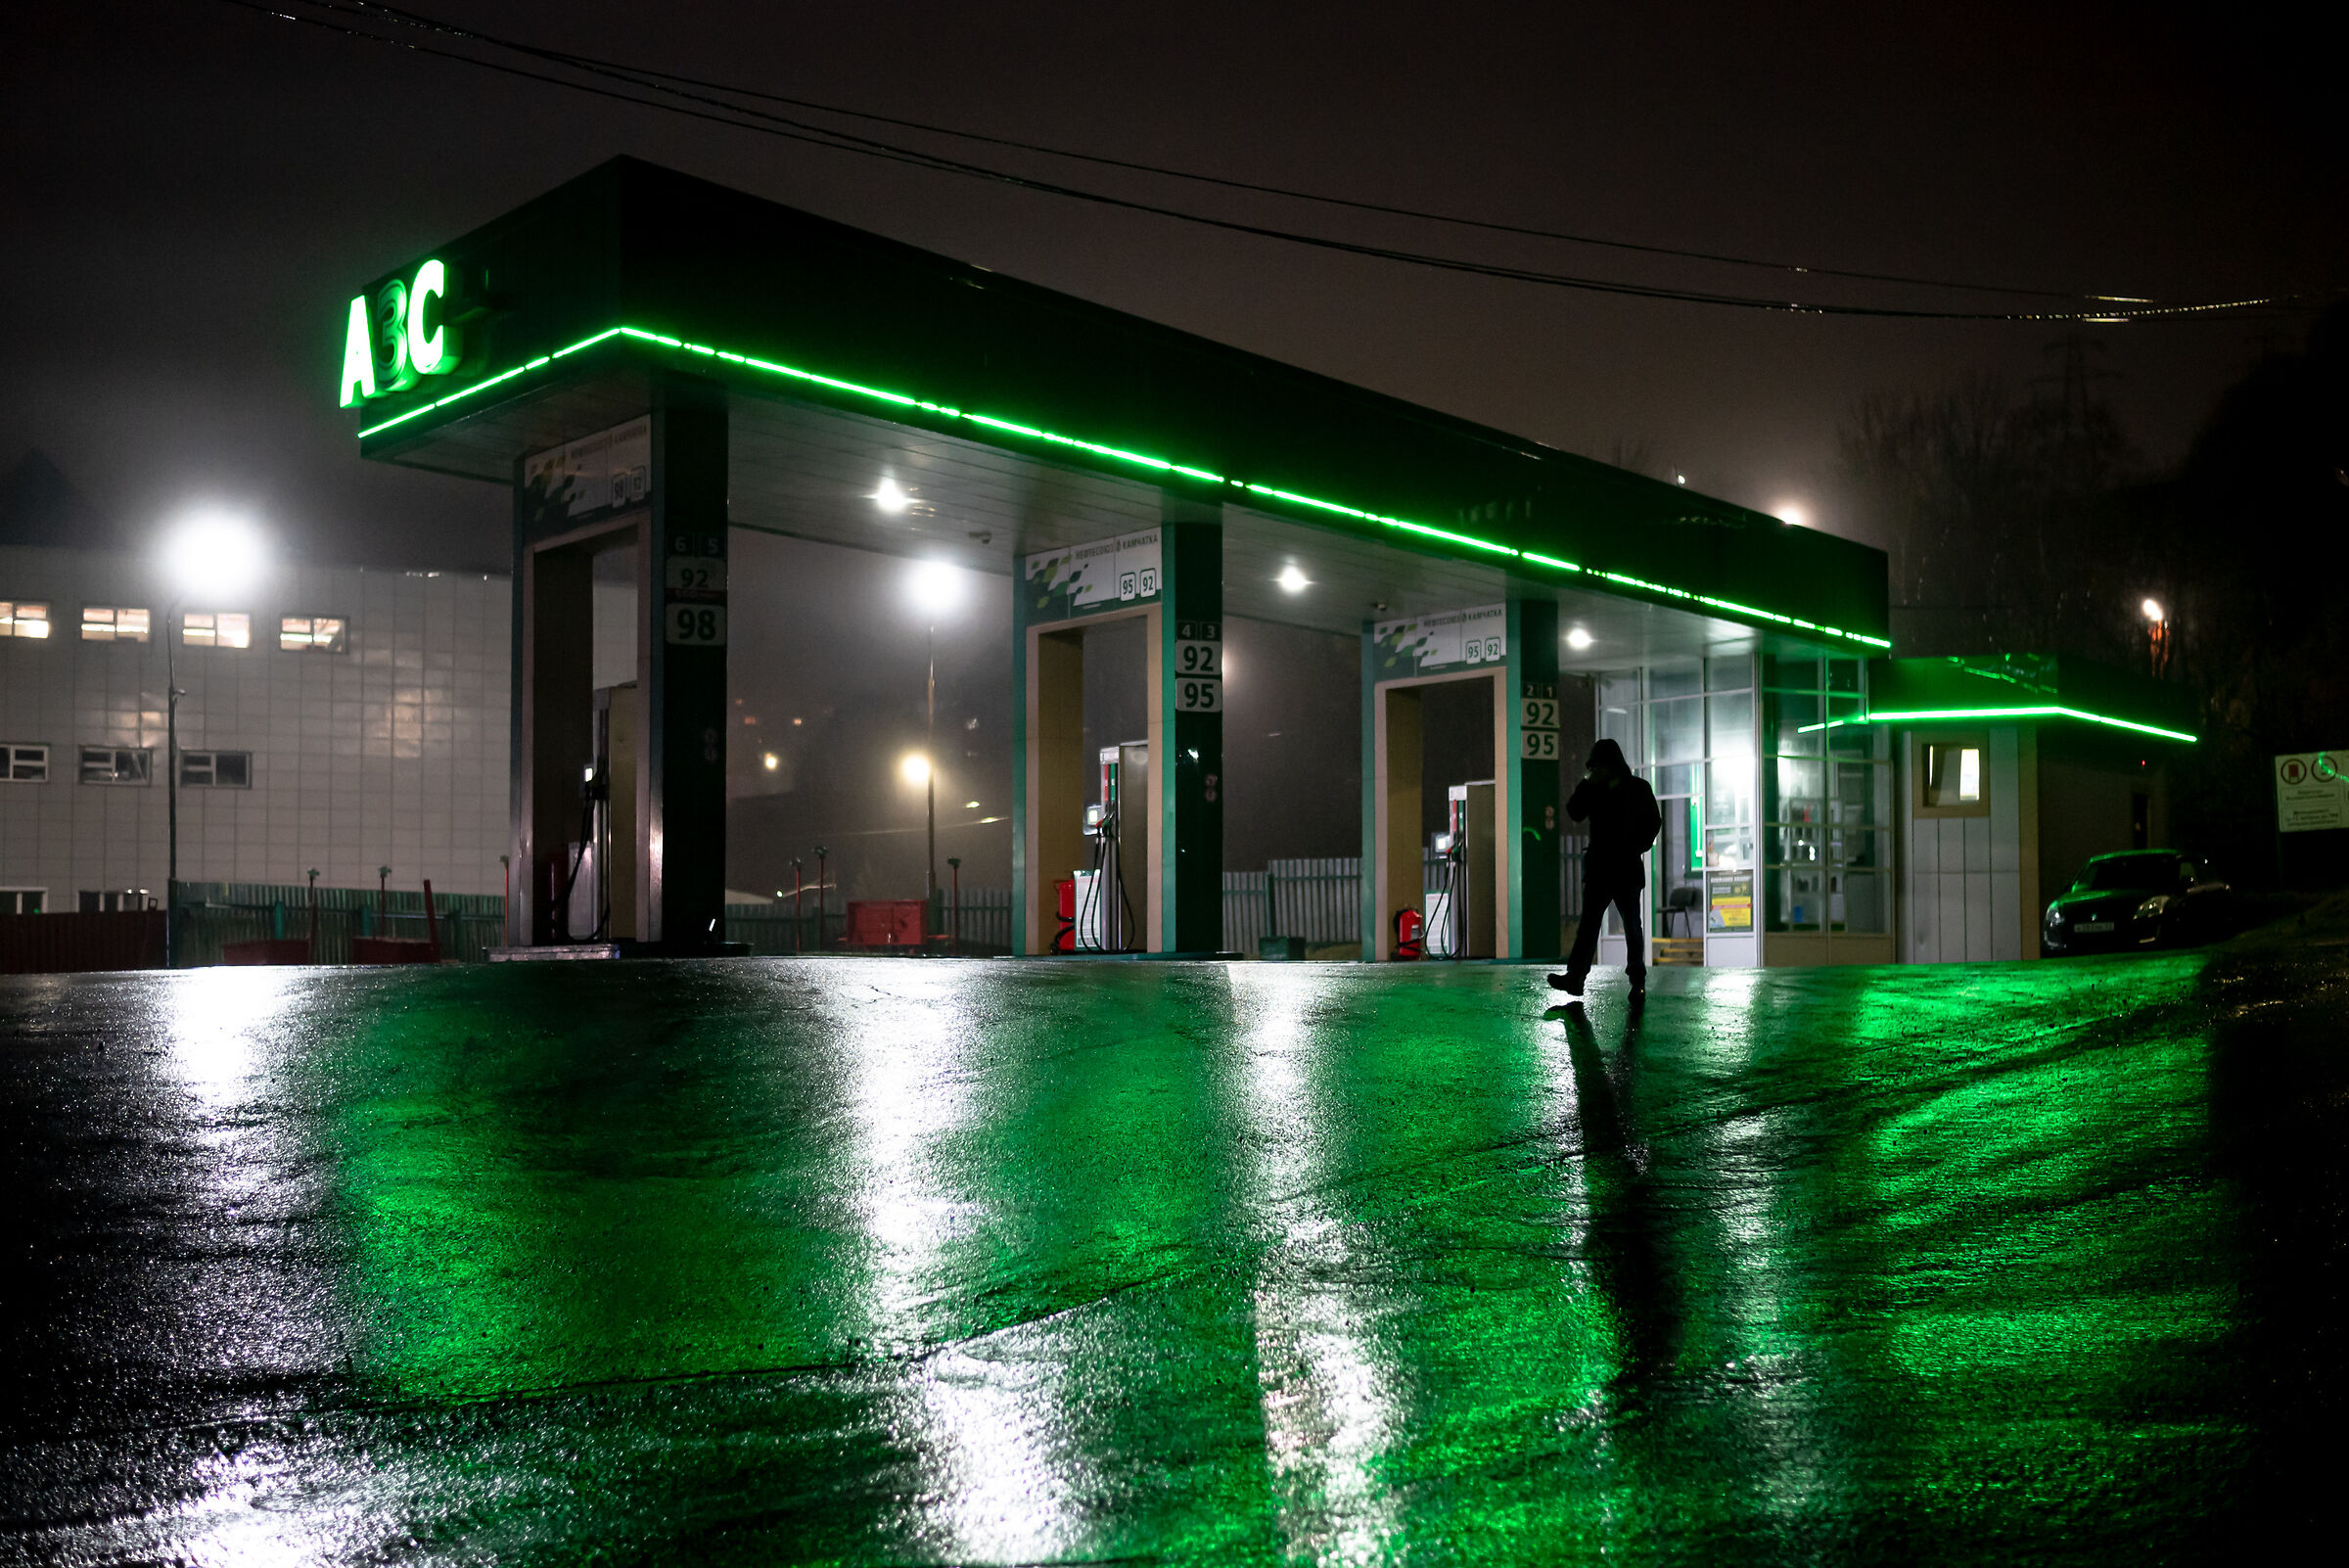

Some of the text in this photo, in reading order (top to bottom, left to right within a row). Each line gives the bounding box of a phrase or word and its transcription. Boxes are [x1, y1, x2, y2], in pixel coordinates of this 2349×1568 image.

[340, 258, 445, 408] АЗС
[674, 535, 719, 555] 6 5
[1123, 533, 1158, 549] КАМЧАТКА
[680, 568, 709, 587] 92
[1123, 576, 1153, 595] 95 92
[677, 609, 715, 640] 98
[1181, 624, 1216, 639] 4 3
[1183, 645, 1214, 671] 92
[1468, 643, 1498, 659] 95 92
[1184, 682, 1215, 708] 95
[1527, 684, 1553, 698] 2 1
[1526, 702, 1553, 726] 92
[1527, 733, 1554, 757] 95
